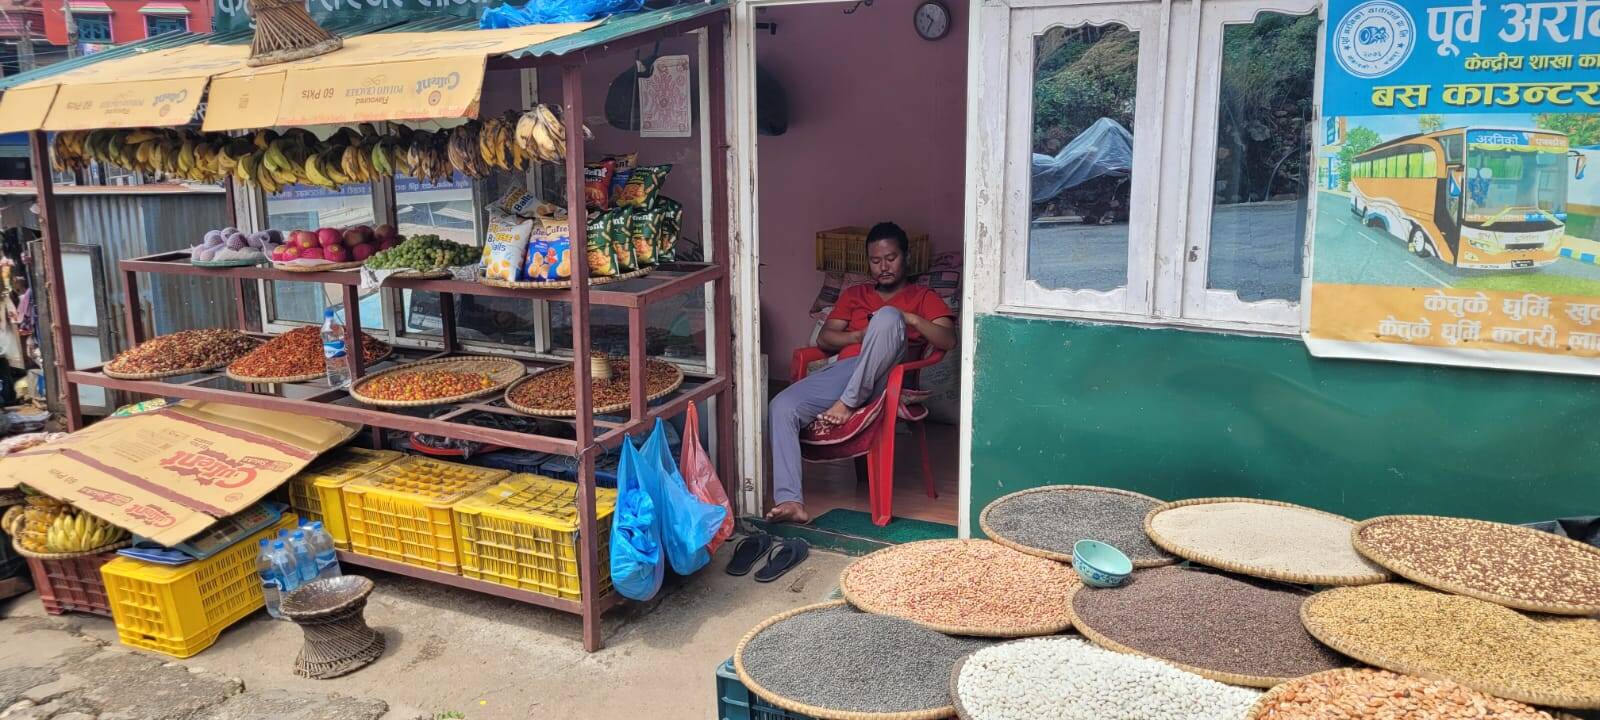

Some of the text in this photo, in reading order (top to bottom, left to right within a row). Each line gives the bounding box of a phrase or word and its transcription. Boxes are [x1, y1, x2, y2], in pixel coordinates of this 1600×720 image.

[1465, 52, 1524, 72] केन्द्रीय
[1529, 54, 1574, 70] शाखा
[324, 88, 335, 99] 60
[1372, 85, 1431, 107] बस
